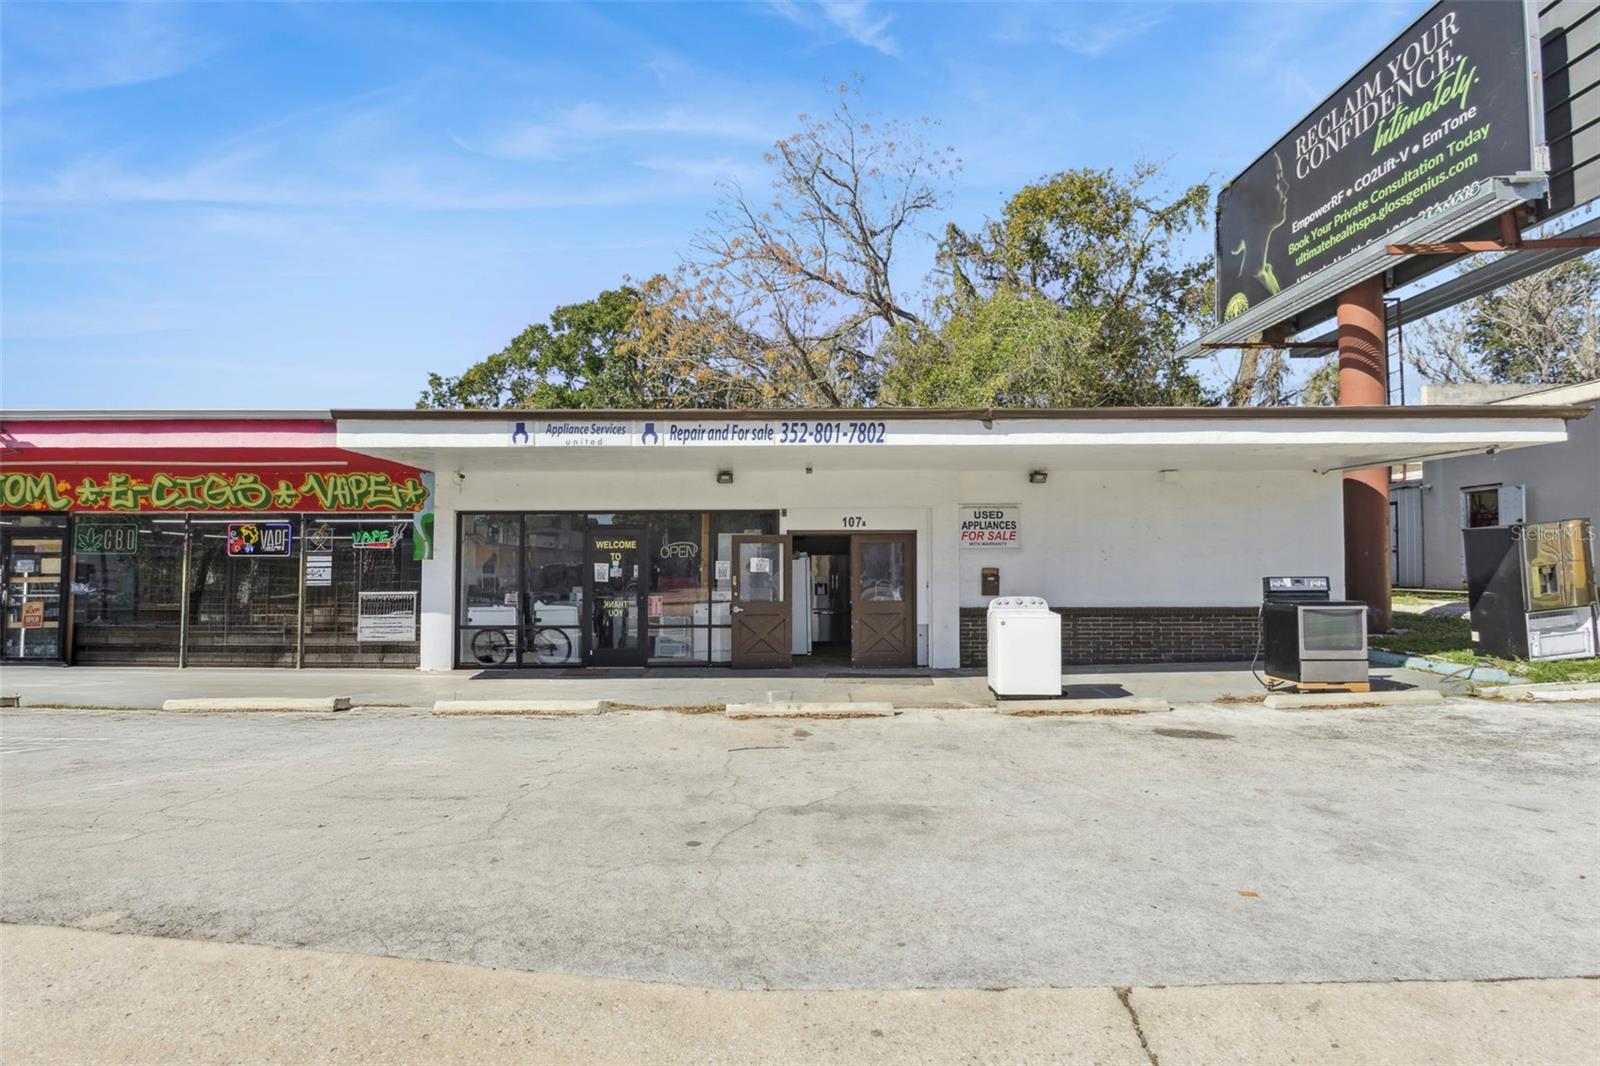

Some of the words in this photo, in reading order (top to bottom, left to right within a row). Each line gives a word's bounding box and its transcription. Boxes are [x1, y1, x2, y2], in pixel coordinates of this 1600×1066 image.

[1296, 71, 1382, 160] RECLAIM
[1387, 11, 1460, 83] YOUR
[1296, 39, 1463, 179] CONFIDENCE.
[1371, 56, 1480, 156] Intimately.
[1291, 190, 1344, 233] EmpowerRF
[1354, 146, 1409, 192] CO2Lift-V
[1422, 105, 1477, 149] EmTone
[1288, 233, 1310, 255] Book
[1310, 220, 1332, 241] Your
[1333, 199, 1369, 228] Private
[1370, 152, 1444, 204] Consultation
[1446, 123, 1490, 157] Today
[1295, 152, 1478, 267] ultimatehealthspa.glossgenius.com
[545, 423, 589, 436] Appliance
[590, 423, 626, 435] Services
[669, 424, 706, 445] Repair
[707, 424, 731, 441] and
[732, 424, 751, 441] For
[751, 424, 774, 441] sale
[779, 422, 886, 444] 352-801-7802
[565, 438, 603, 446] united
[300, 472, 406, 511] VAPE
[973, 510, 1004, 520] USED
[961, 520, 1017, 530] APPLIANCES
[104, 529, 134, 550] CBD
[352, 529, 389, 544] VAPE
[596, 540, 637, 549] WELCOME
[961, 531, 985, 541] FOR
[987, 531, 1017, 541] SALE
[609, 553, 622, 561] TO
[660, 545, 697, 558] OPEN
